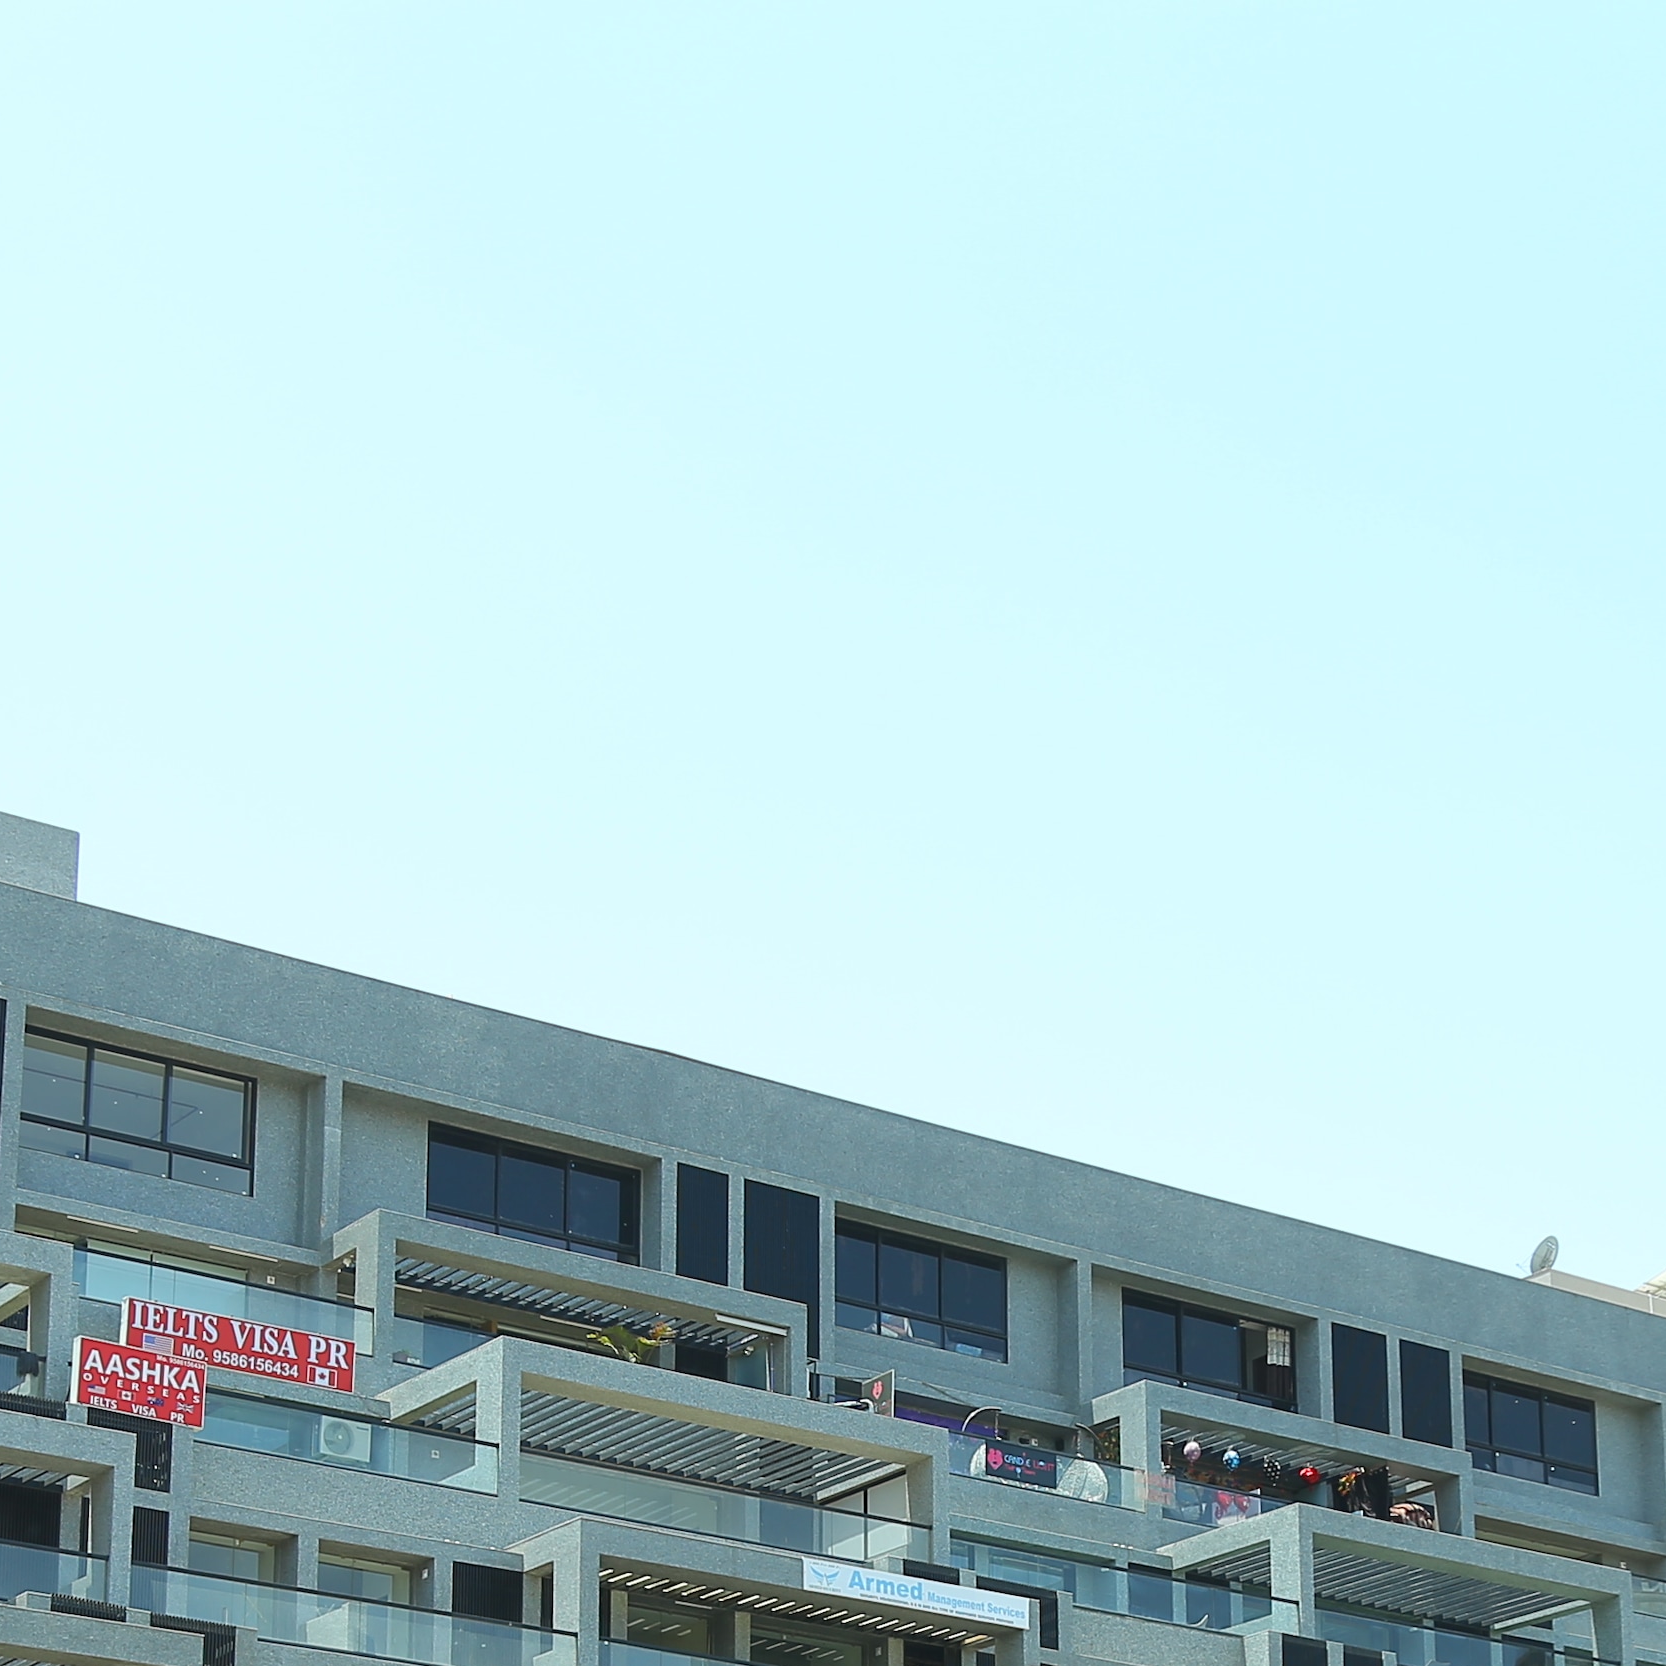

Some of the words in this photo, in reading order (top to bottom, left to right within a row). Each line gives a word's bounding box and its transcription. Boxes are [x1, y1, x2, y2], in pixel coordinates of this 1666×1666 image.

[131, 1301, 220, 1344] IELTS
[230, 1319, 297, 1359] VISA
[307, 1336, 348, 1369] PR
[84, 1349, 200, 1394] AASHKA
[182, 1344, 208, 1362] Mo.
[213, 1351, 299, 1378] 9586156434
[83, 1372, 200, 1403] OVERSEAS
[90, 1395, 118, 1409] IELTS
[132, 1404, 156, 1417] VISA
[171, 1412, 184, 1423] PR
[848, 1570, 923, 1601] Armed
[927, 1591, 985, 1612] Management
[987, 1602, 1025, 1619] Services
